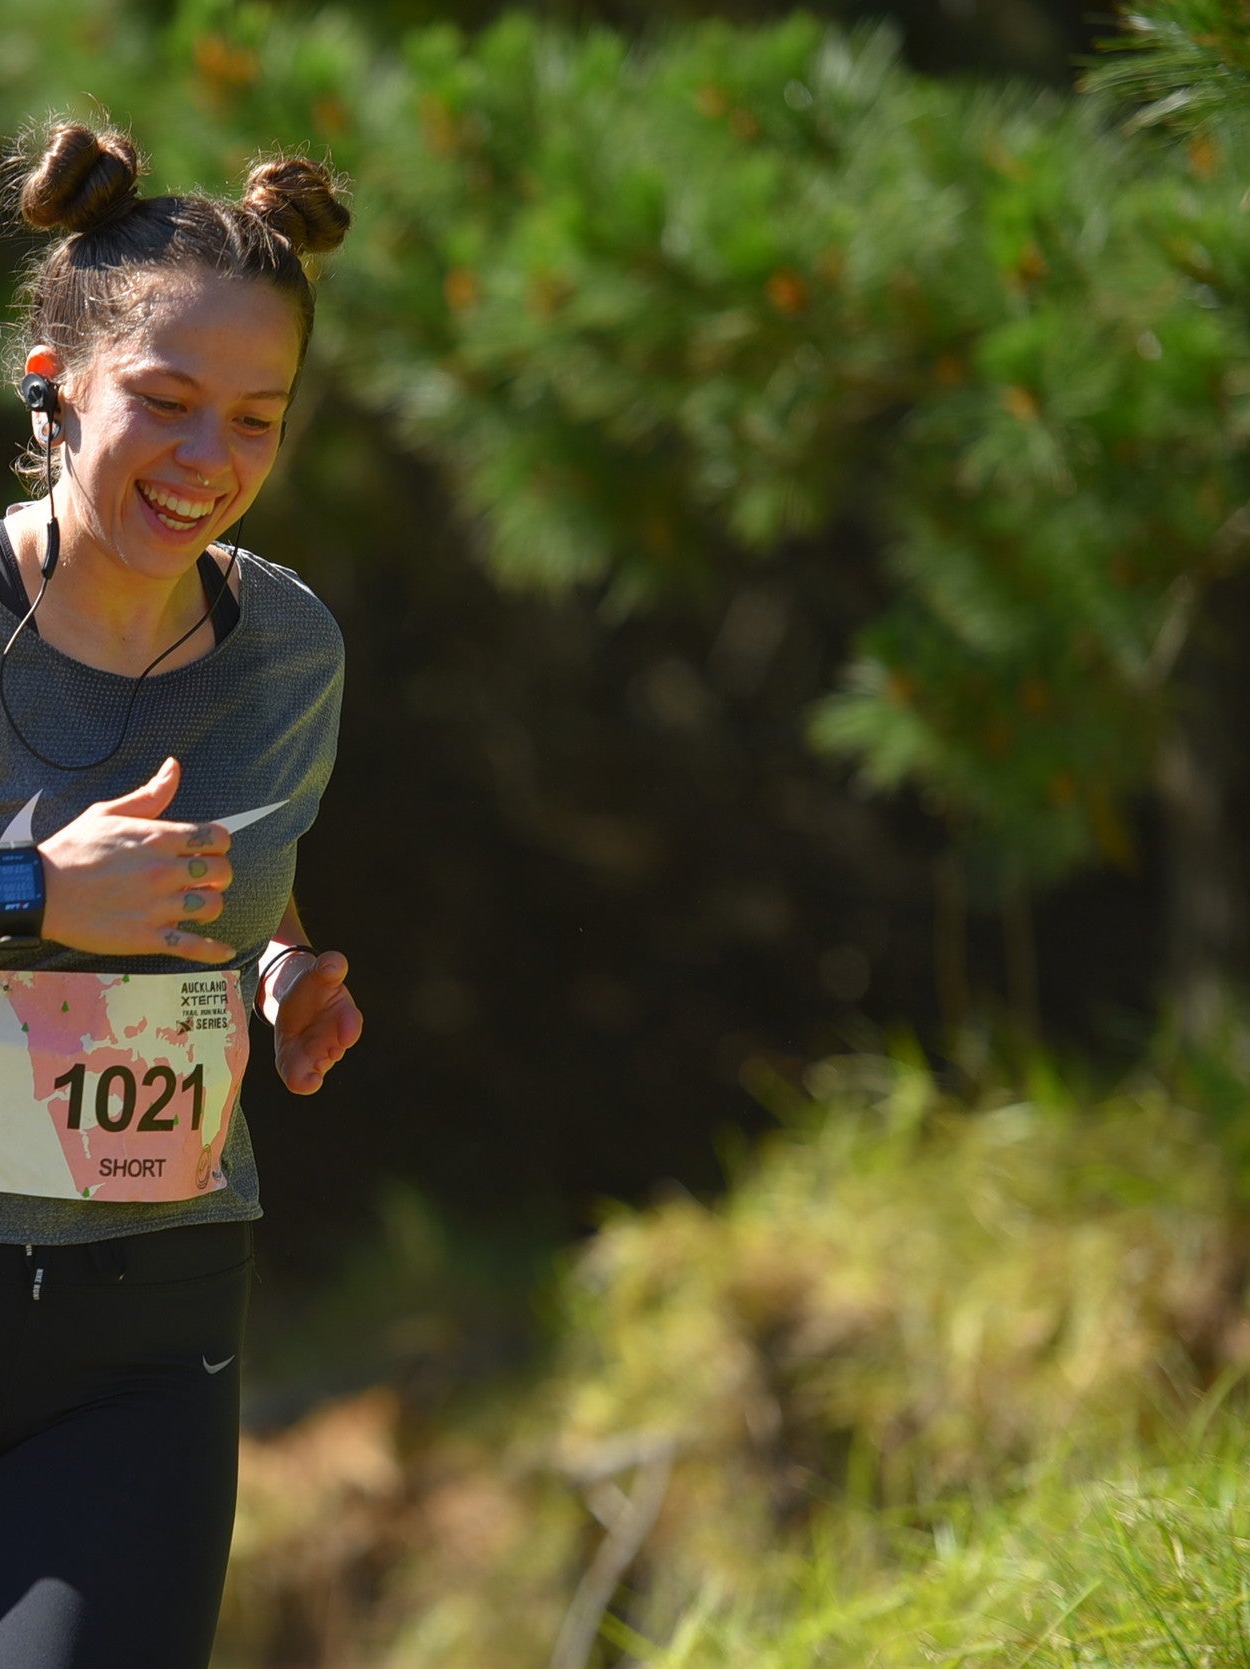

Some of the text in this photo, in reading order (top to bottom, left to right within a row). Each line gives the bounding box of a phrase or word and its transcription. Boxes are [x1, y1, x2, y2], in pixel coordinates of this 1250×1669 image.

[181, 980, 227, 994] AUCKLAND
[196, 1017, 228, 1030] SERIES
[53, 1063, 204, 1132] 1021
[98, 1158, 167, 1178] SHORT
